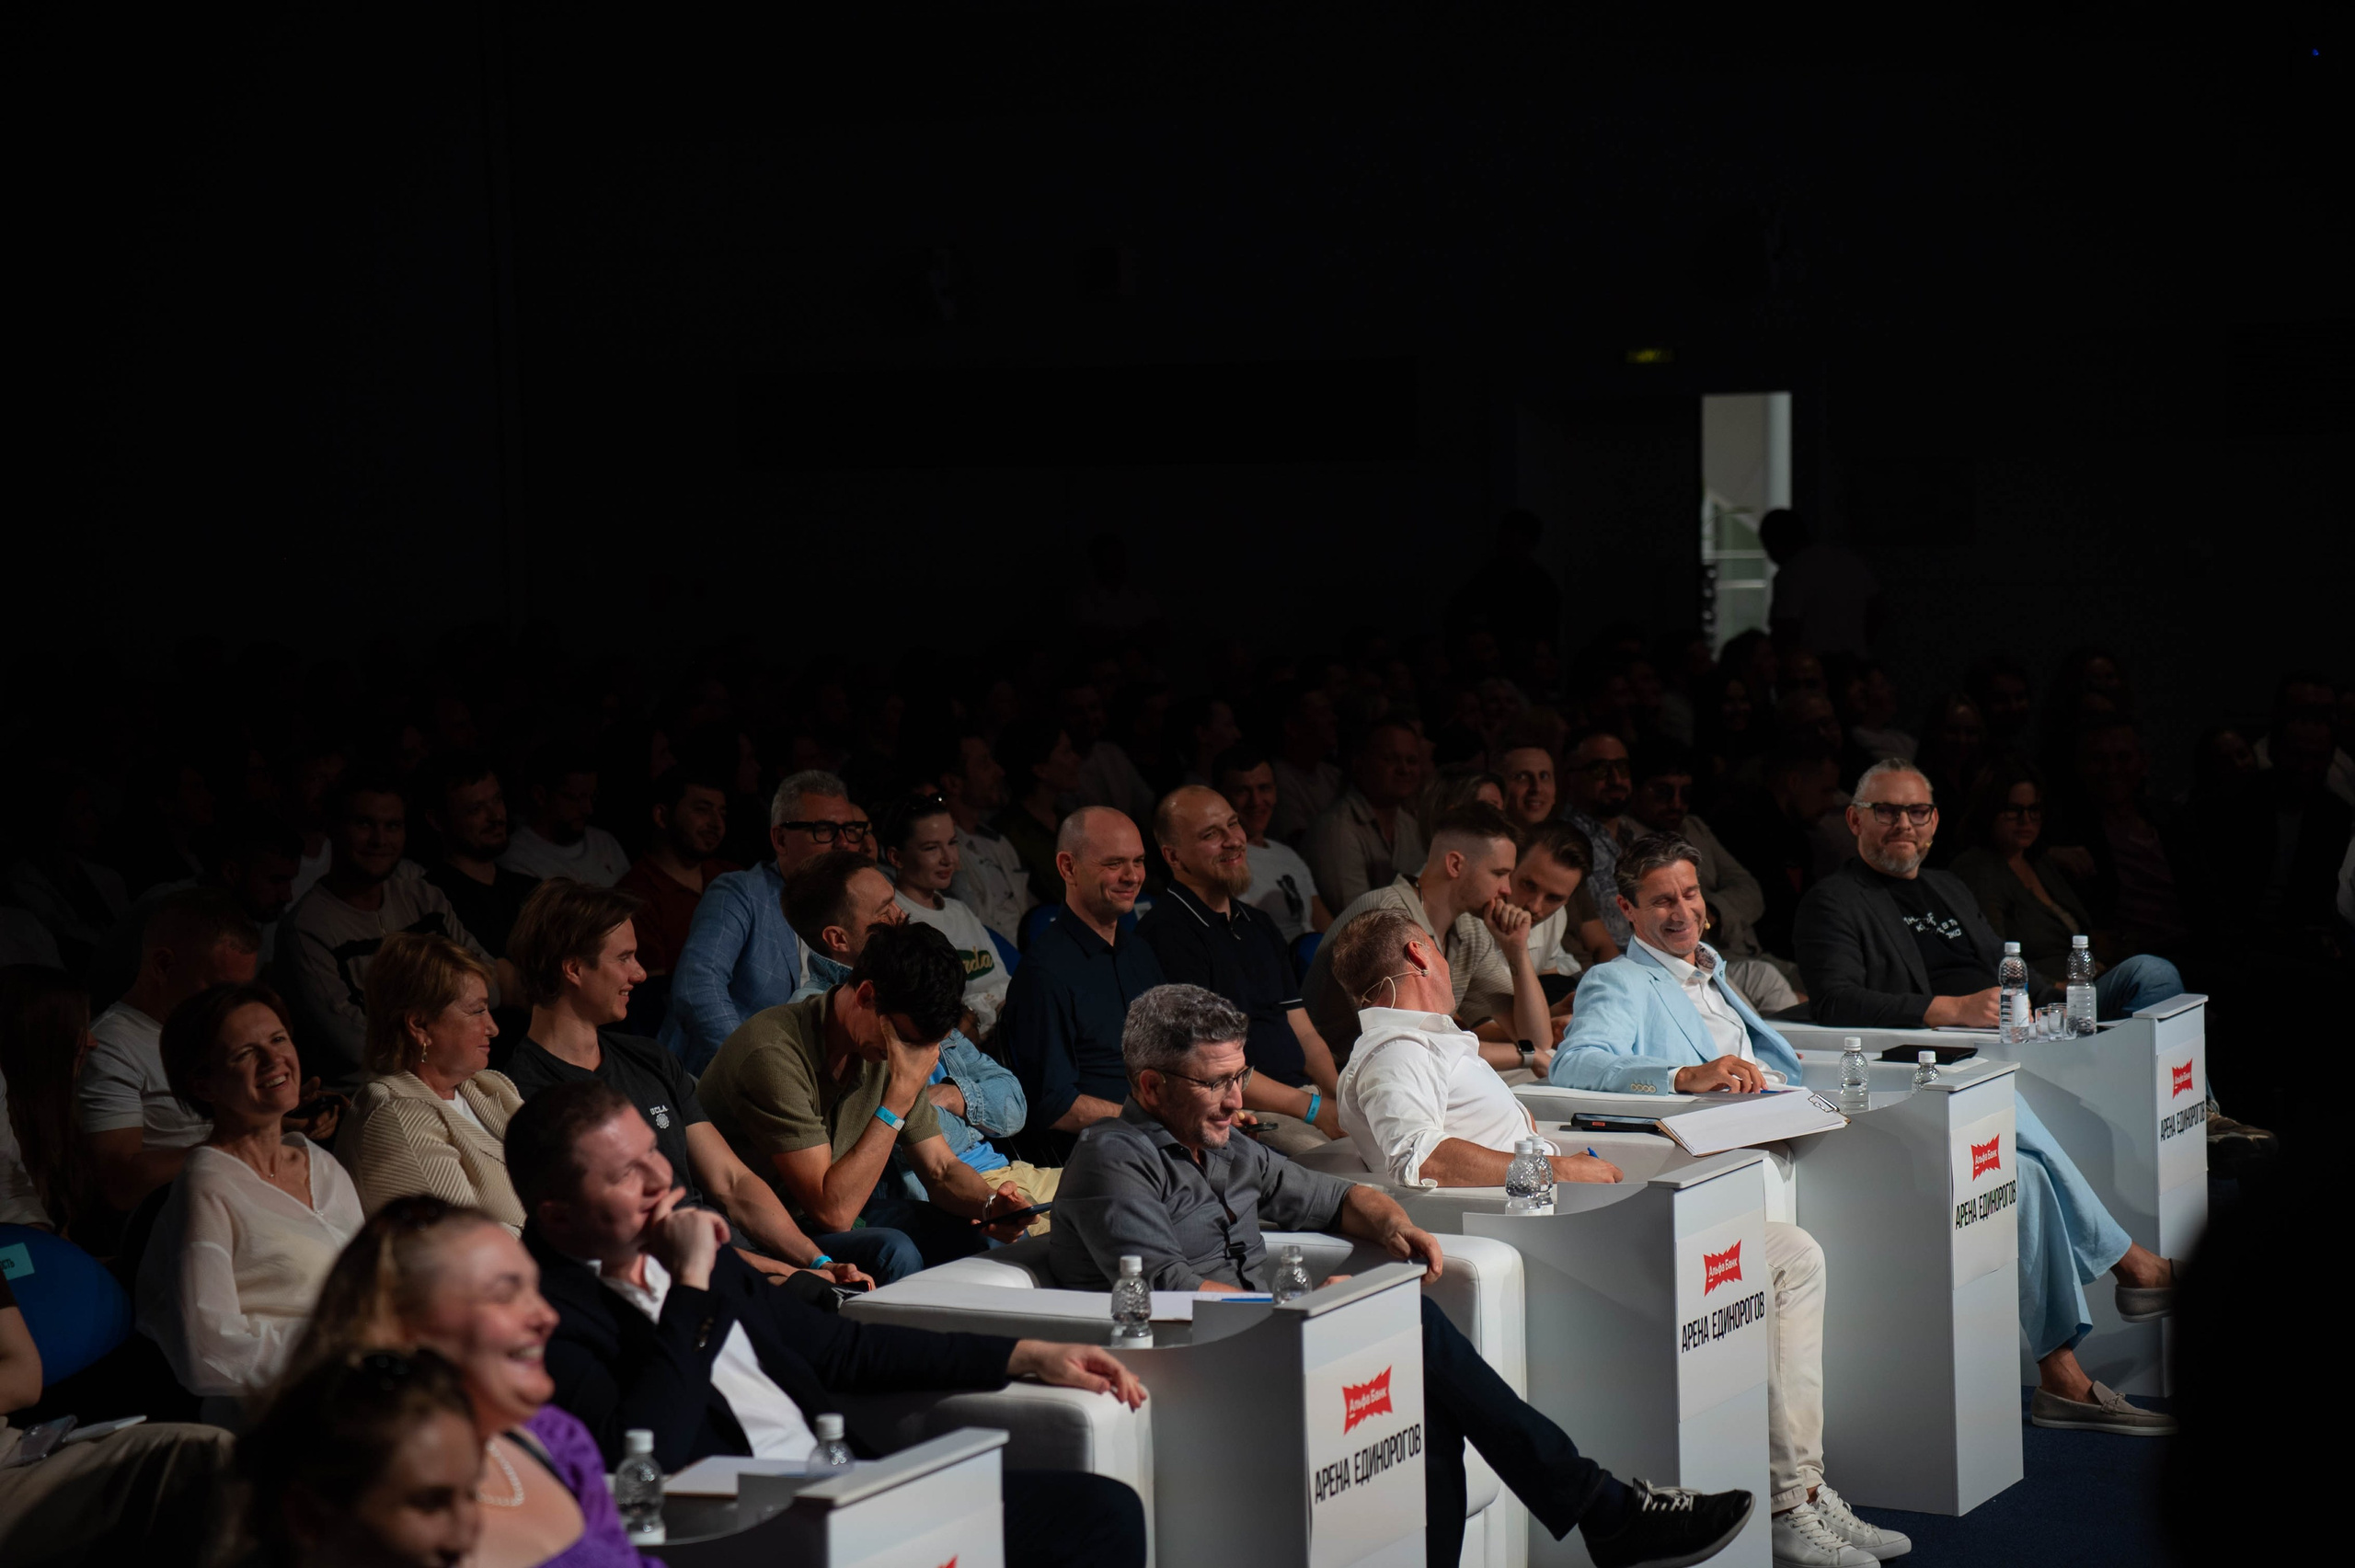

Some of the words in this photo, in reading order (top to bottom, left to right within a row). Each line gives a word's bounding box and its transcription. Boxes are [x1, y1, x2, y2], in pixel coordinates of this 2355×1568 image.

[649, 1104, 669, 1116] UCLA
[1955, 1197, 1978, 1230] АРЕНА
[1979, 1179, 2016, 1222] ЕДИНОРОГОВ
[1708, 1261, 1725, 1278] Альфа
[1725, 1257, 1738, 1270] Банк
[1682, 1315, 1710, 1354] АРЕНА
[1712, 1290, 1765, 1342] ЕДИНОРОГОВ
[1349, 1394, 1371, 1414] Альфа
[1371, 1386, 1387, 1404] Банк
[1315, 1457, 1351, 1505] АРЕНА
[1354, 1423, 1422, 1487] ЕДИНОРОГОВ
